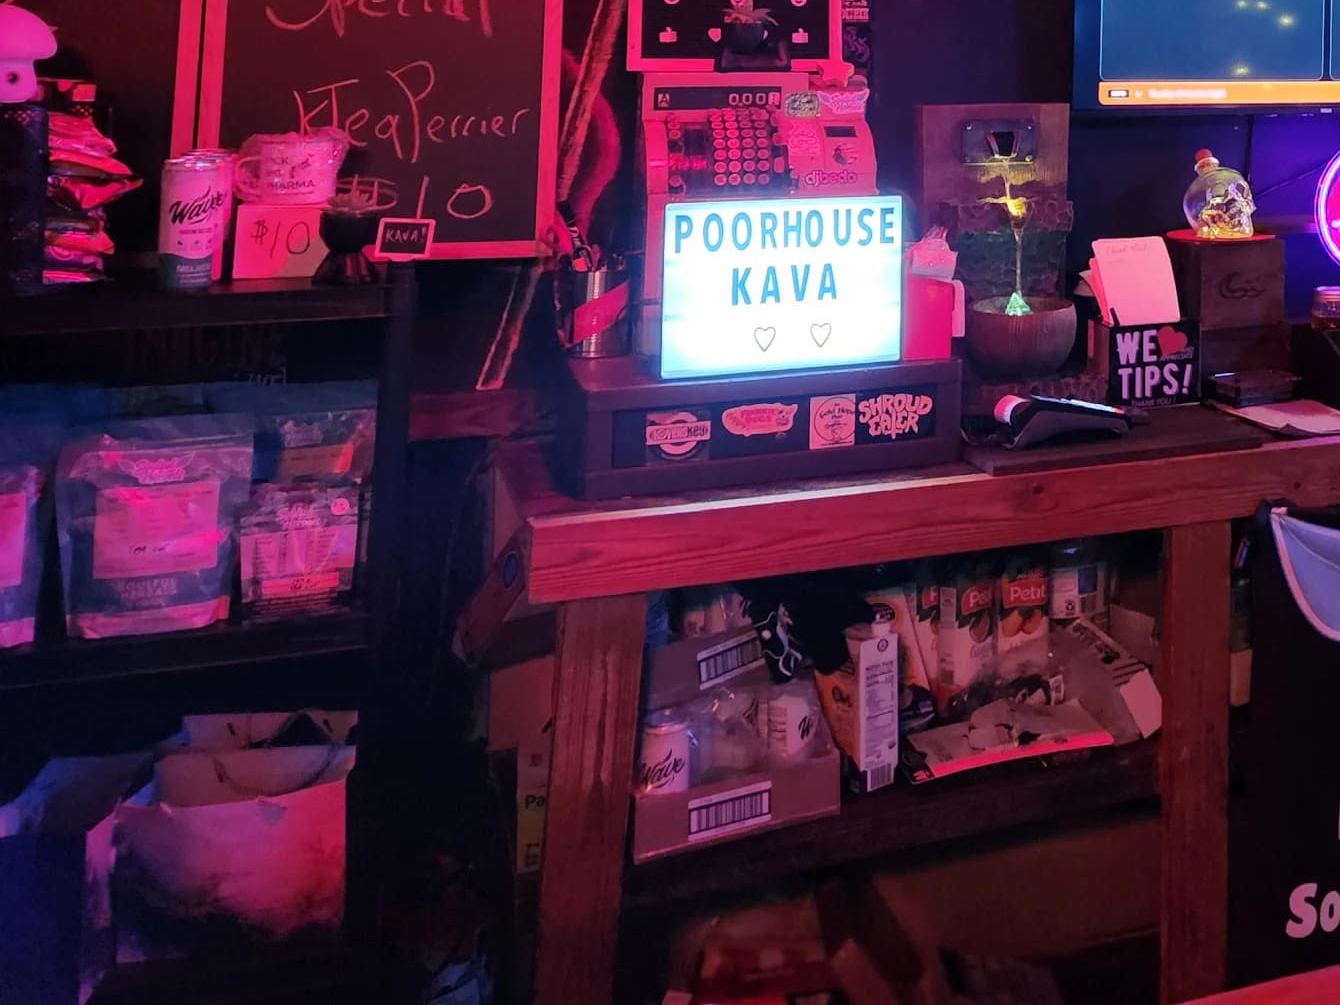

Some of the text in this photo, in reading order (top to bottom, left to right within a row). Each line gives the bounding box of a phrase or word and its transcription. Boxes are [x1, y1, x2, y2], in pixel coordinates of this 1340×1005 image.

[251, 219, 311, 260] $10
[673, 206, 895, 254] POORHOUSE
[730, 262, 838, 307] KAVA
[1115, 328, 1158, 366] WE
[1117, 362, 1193, 400] TIPS!
[858, 394, 933, 424] SHROUD
[868, 411, 919, 440] EATER
[1009, 583, 1047, 602] Petit
